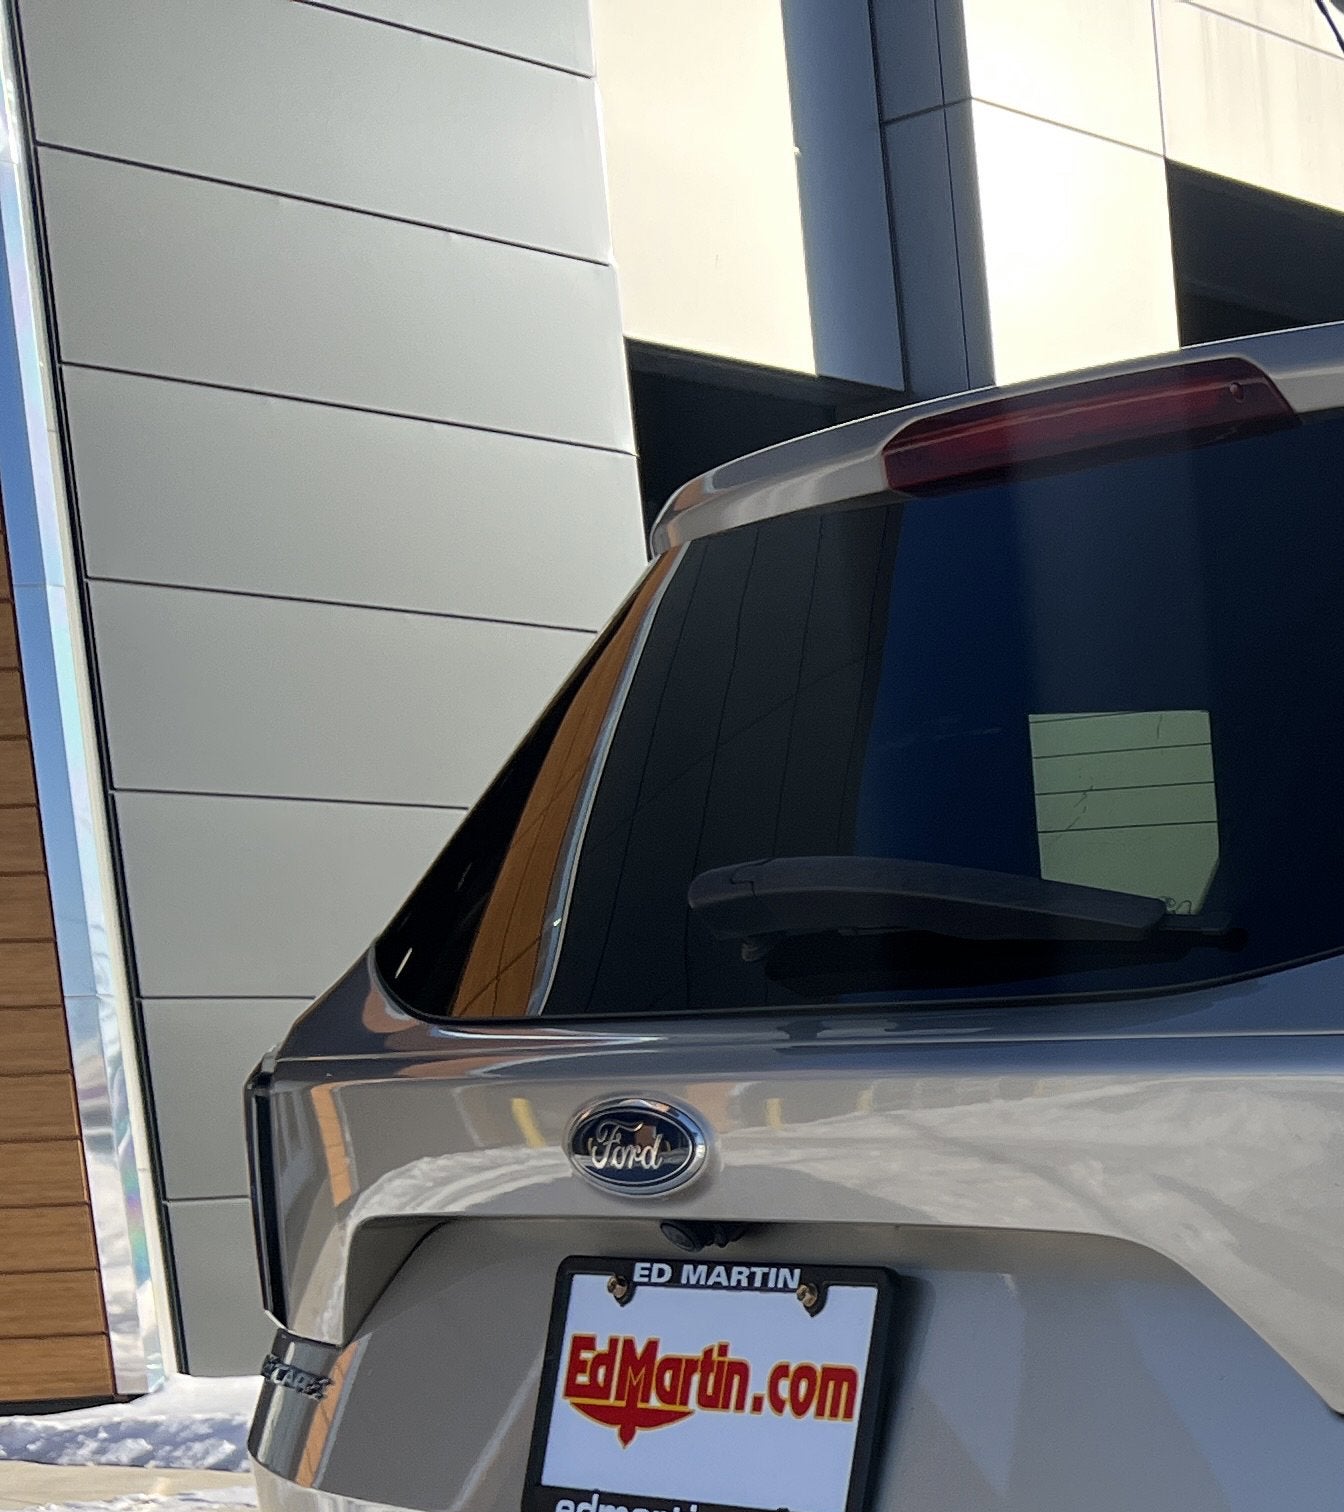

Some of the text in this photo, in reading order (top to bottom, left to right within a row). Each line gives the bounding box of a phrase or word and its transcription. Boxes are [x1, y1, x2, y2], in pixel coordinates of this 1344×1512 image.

[588, 1120, 665, 1171] Ford
[633, 1263, 800, 1290] ED MARTIN
[563, 1332, 859, 1423] EdMartin.com
